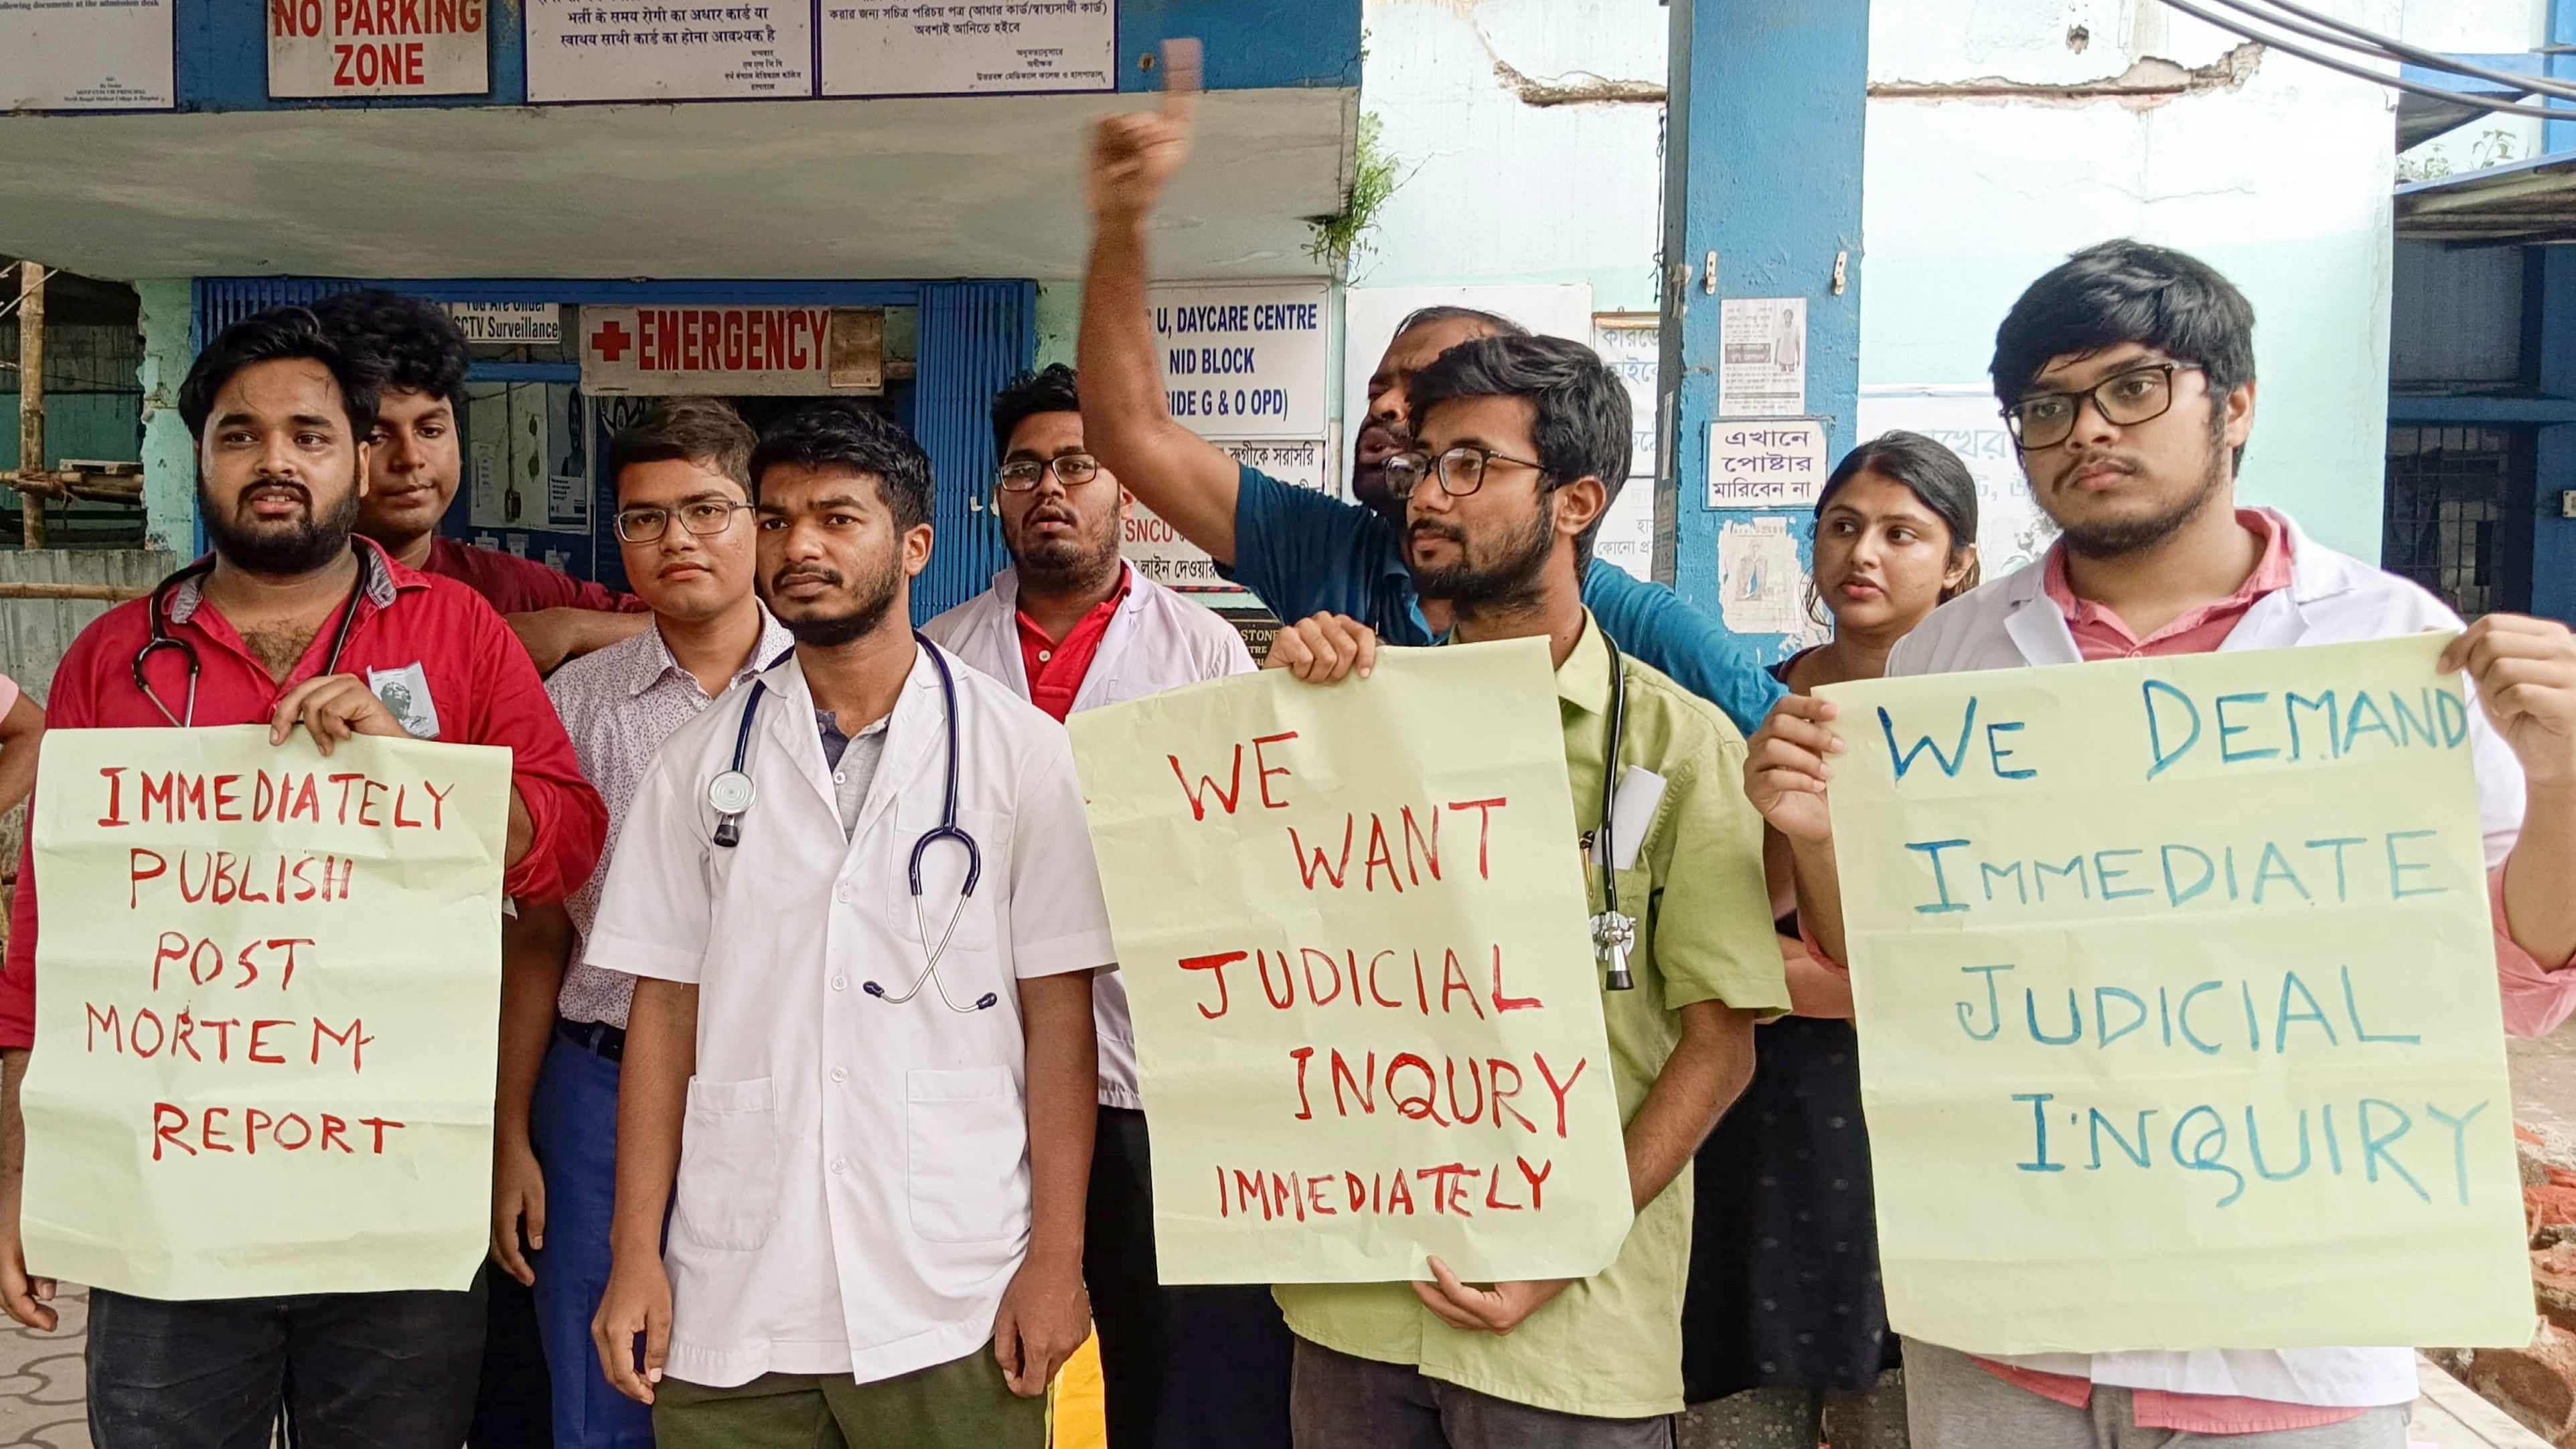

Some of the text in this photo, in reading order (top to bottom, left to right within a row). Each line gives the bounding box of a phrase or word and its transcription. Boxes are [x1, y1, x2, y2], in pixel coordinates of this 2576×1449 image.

[275, 0, 481, 37] NO PARKING
[568, 8, 592, 24] भर्ती
[595, 8, 606, 23] के
[610, 11, 639, 24] समय
[642, 6, 668, 25] रोगी
[671, 9, 687, 22] का
[726, 4, 751, 20] कार्ड
[754, 7, 769, 20] या
[601, 29, 629, 47] साथी
[634, 27, 659, 46] कार्ड
[662, 32, 678, 44] का
[682, 27, 708, 45] होना
[712, 29, 765, 44] आवश्यक
[765, 24, 775, 44] है
[829, 9, 856, 20] করার
[334, 43, 425, 86] ZONE
[488, 316, 558, 338] Surveillance
[1177, 305, 1248, 333] DAYCARE
[1254, 303, 1317, 331] CENTRE
[638, 310, 830, 371] EMERGENCY
[1170, 347, 1256, 375] NID BLOCK
[1201, 390, 1213, 416] G
[1218, 390, 1229, 416] &
[1235, 389, 1245, 416] O
[1251, 388, 1288, 421] OPD)
[1273, 442, 1316, 467] সরাসরি
[1725, 429, 1811, 447] এখানে
[1720, 451, 1813, 473] পোষ্টার
[1712, 477, 1785, 498] মারিবেন
[1791, 480, 1811, 498] না
[1125, 519, 1173, 542] SNCU
[1140, 554, 1171, 581] লাইন
[1247, 645, 1268, 654] TRE
[1877, 678, 2467, 787] WE DEMAND
[1167, 731, 1298, 821] WE
[98, 767, 455, 830] IMMEDIATELY
[1288, 797, 1507, 893] WANT
[130, 848, 354, 909] PUBLISH
[1903, 830, 2449, 913] IMMEDIATE
[152, 931, 316, 991] POST
[1179, 943, 1544, 1020] JUDICIAL
[1955, 964, 2421, 1055] JUDICIAL
[85, 1001, 375, 1074] MORTEM
[1290, 1046, 1586, 1138] INQURY
[152, 1101, 406, 1161] REPORT
[2010, 1092, 2490, 1208] INQUIRY
[1215, 1155, 1551, 1223] IMMEDIATELY
